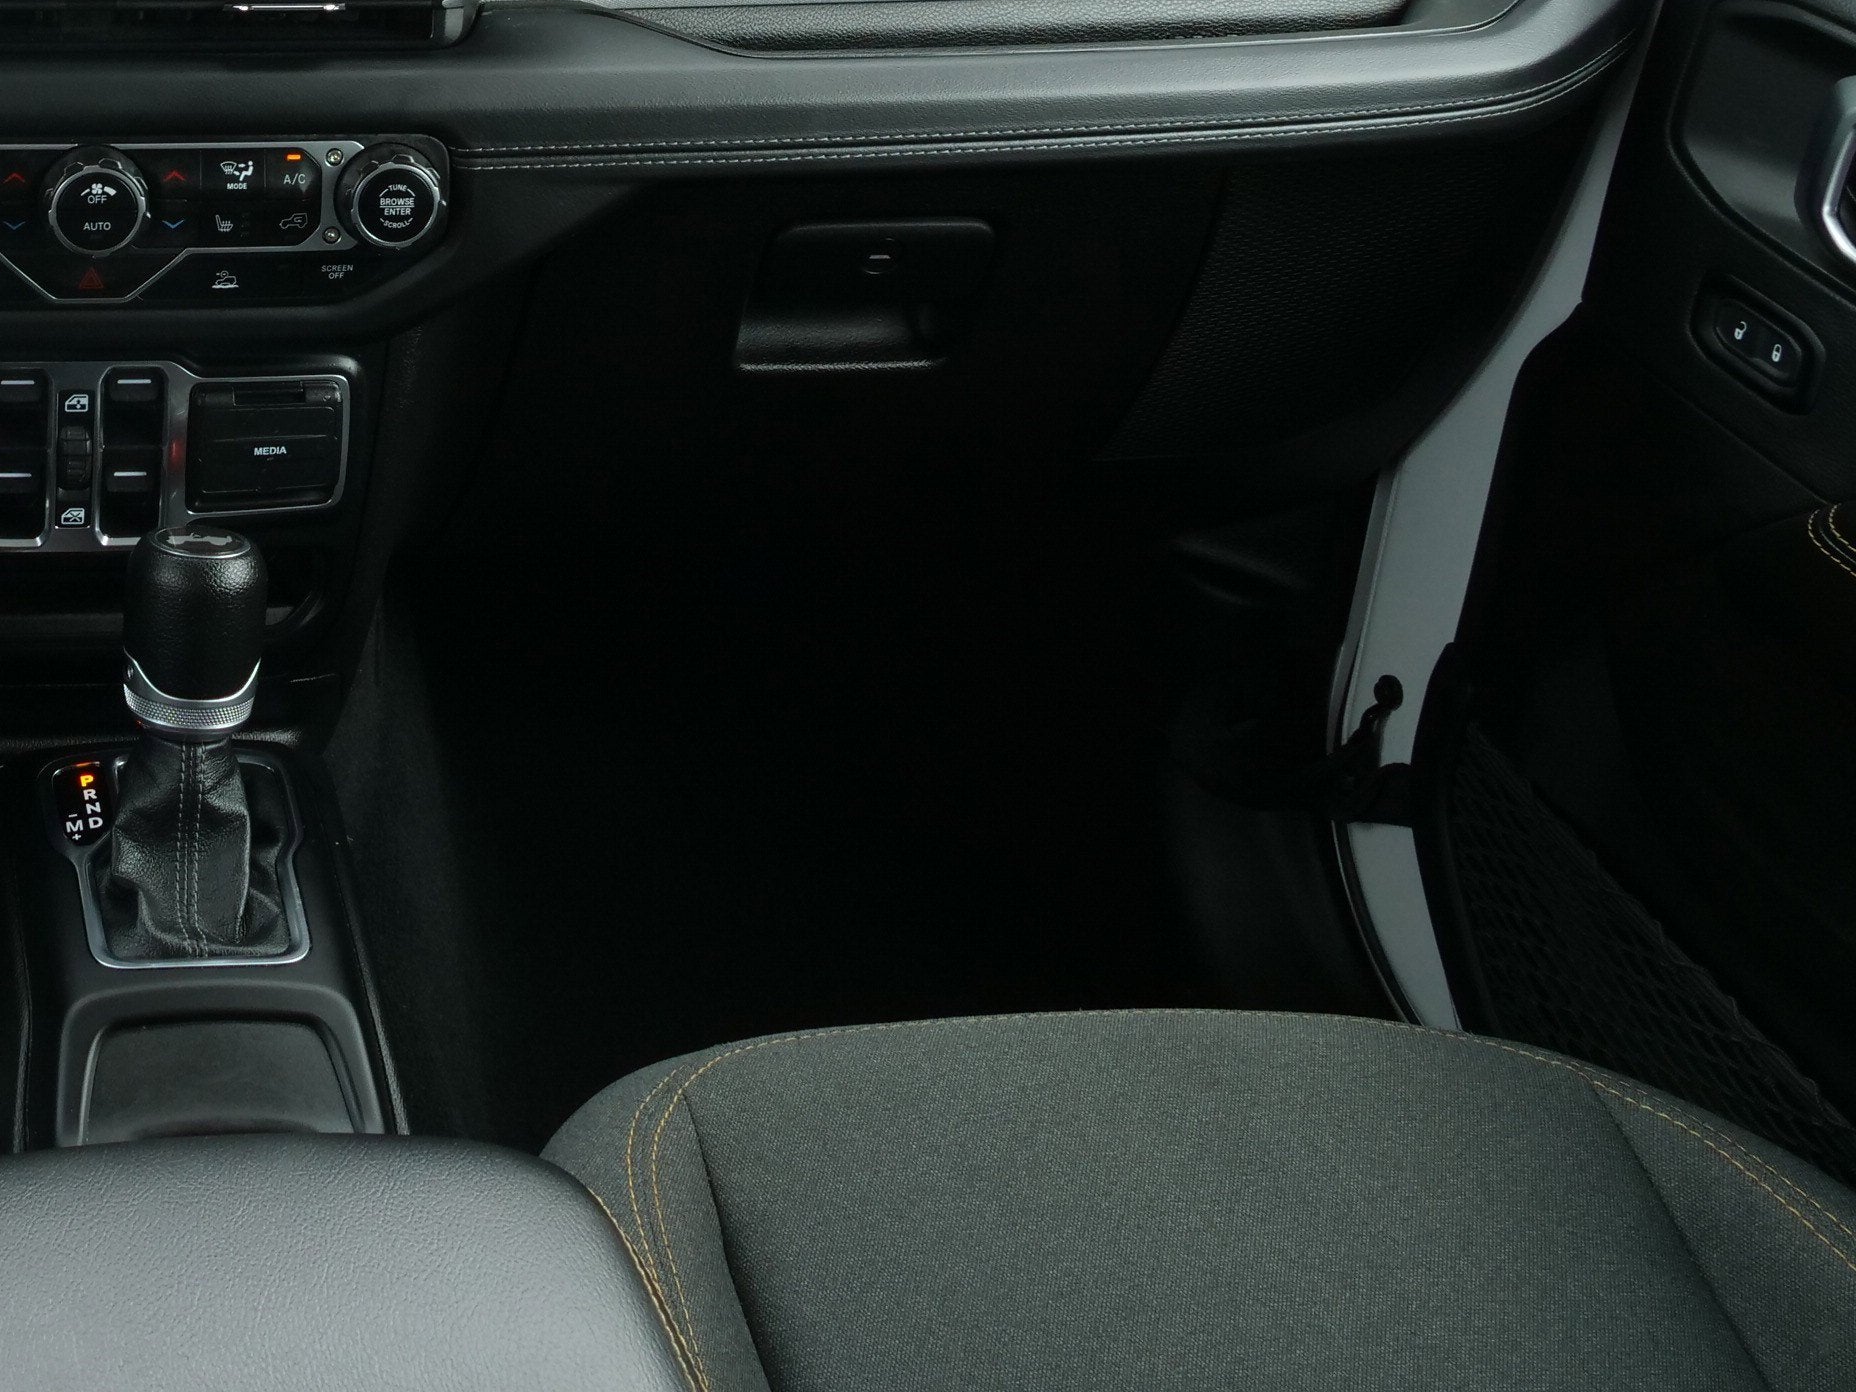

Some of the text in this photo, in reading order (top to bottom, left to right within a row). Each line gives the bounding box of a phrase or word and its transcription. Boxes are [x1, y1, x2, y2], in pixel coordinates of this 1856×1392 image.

[283, 174, 306, 186] A/C
[226, 182, 248, 190] MODE
[388, 184, 408, 192] TUNE
[87, 195, 108, 205] OFF
[380, 197, 415, 206] BROWSE
[384, 207, 412, 216] ENTER
[83, 222, 112, 231] AUTO
[383, 218, 411, 230] SCROLL
[321, 264, 354, 273] SCREEN
[328, 272, 344, 280] OFF
[254, 446, 287, 457] MEDIA
[80, 774, 94, 787] P
[83, 788, 98, 801] R
[85, 802, 102, 815] N
[66, 820, 84, 833] M
[88, 816, 104, 830] D
